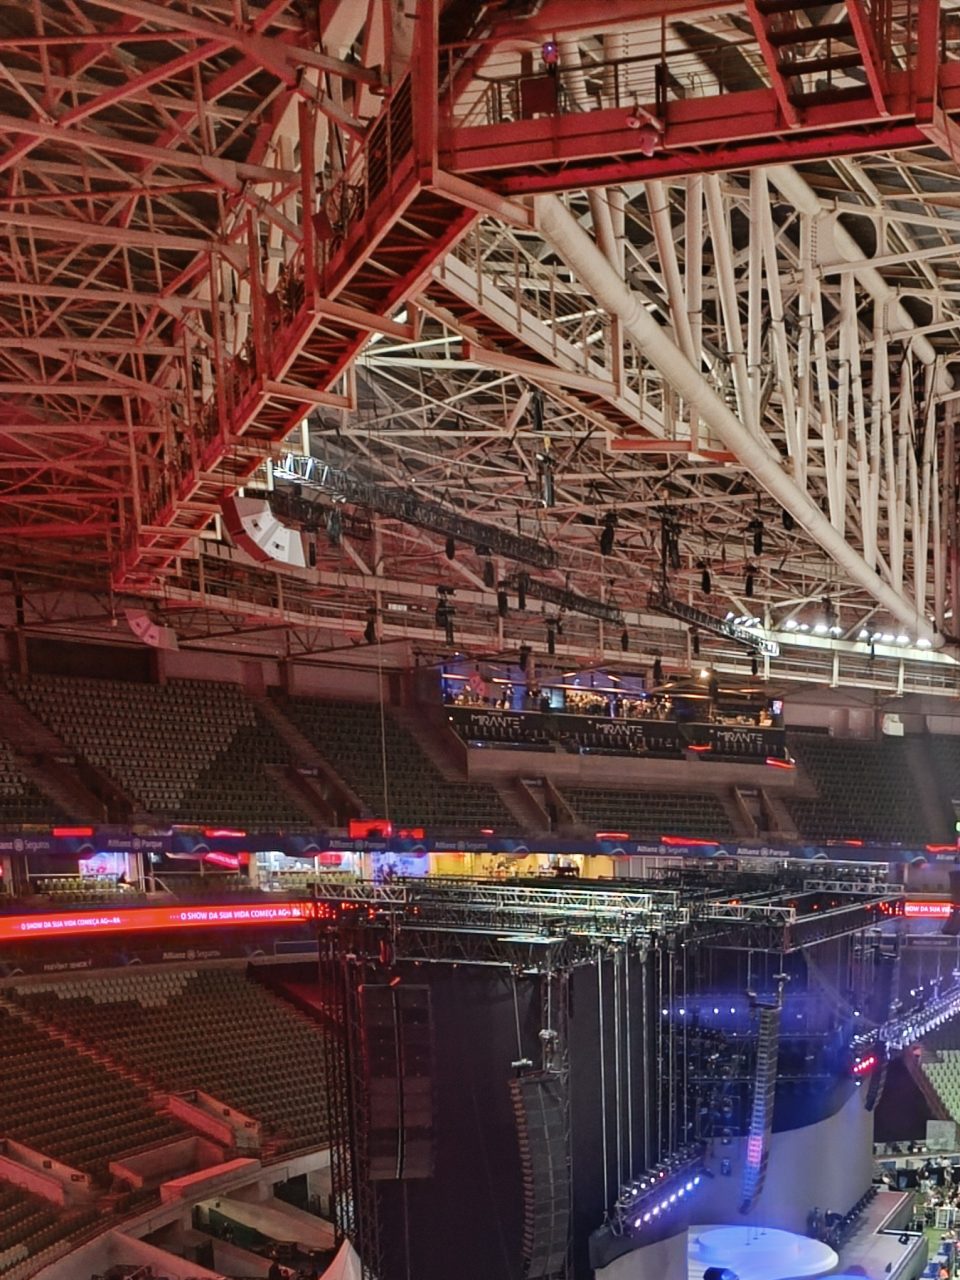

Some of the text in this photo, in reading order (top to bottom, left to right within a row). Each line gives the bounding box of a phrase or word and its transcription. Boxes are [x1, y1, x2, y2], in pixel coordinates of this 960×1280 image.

[471, 714, 520, 729] MIRANTE
[596, 723, 644, 737] MIRANTE
[717, 731, 764, 744] MIRANTE
[636, 845, 658, 853] Allianz
[736, 847, 790, 857] Allianz Parque
